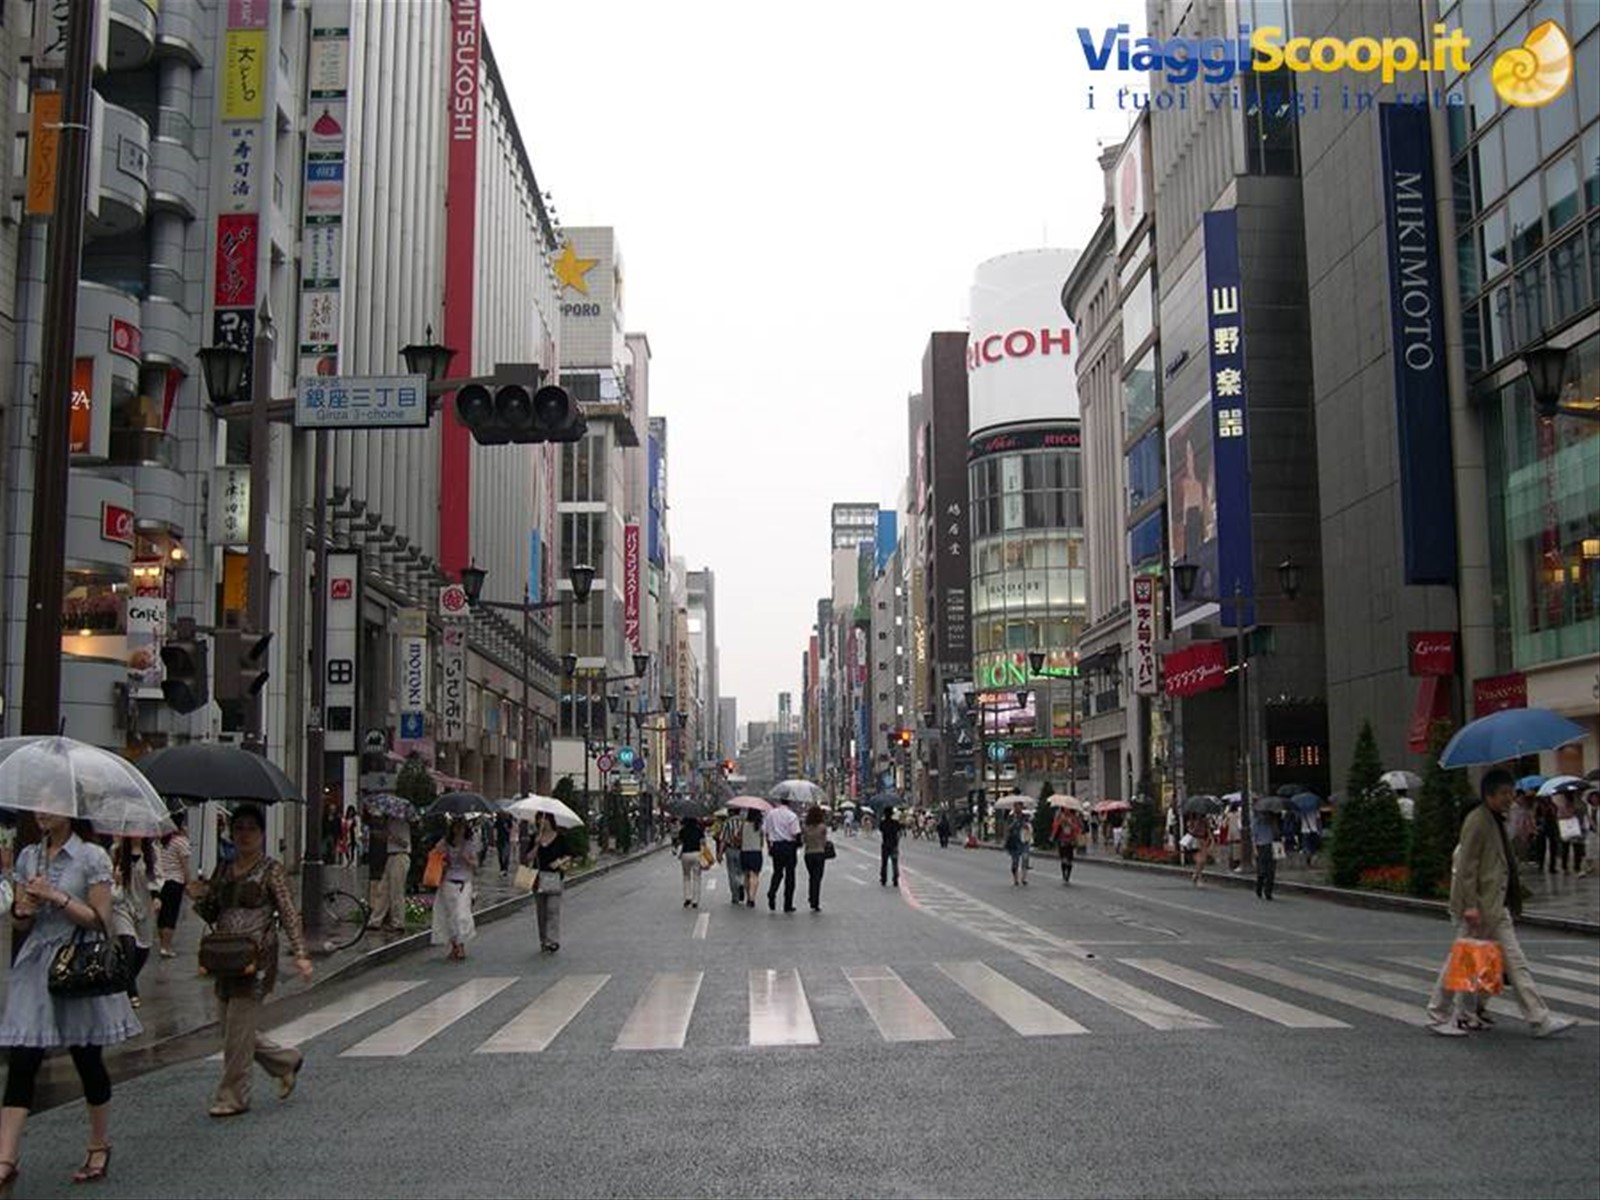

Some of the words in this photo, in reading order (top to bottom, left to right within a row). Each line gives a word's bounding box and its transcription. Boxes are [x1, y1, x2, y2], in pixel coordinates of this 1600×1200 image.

[1393, 171, 1435, 372] MIKIMOTO
[305, 387, 416, 408] 銀座三丁目
[1212, 286, 1244, 438] 山野楽器
